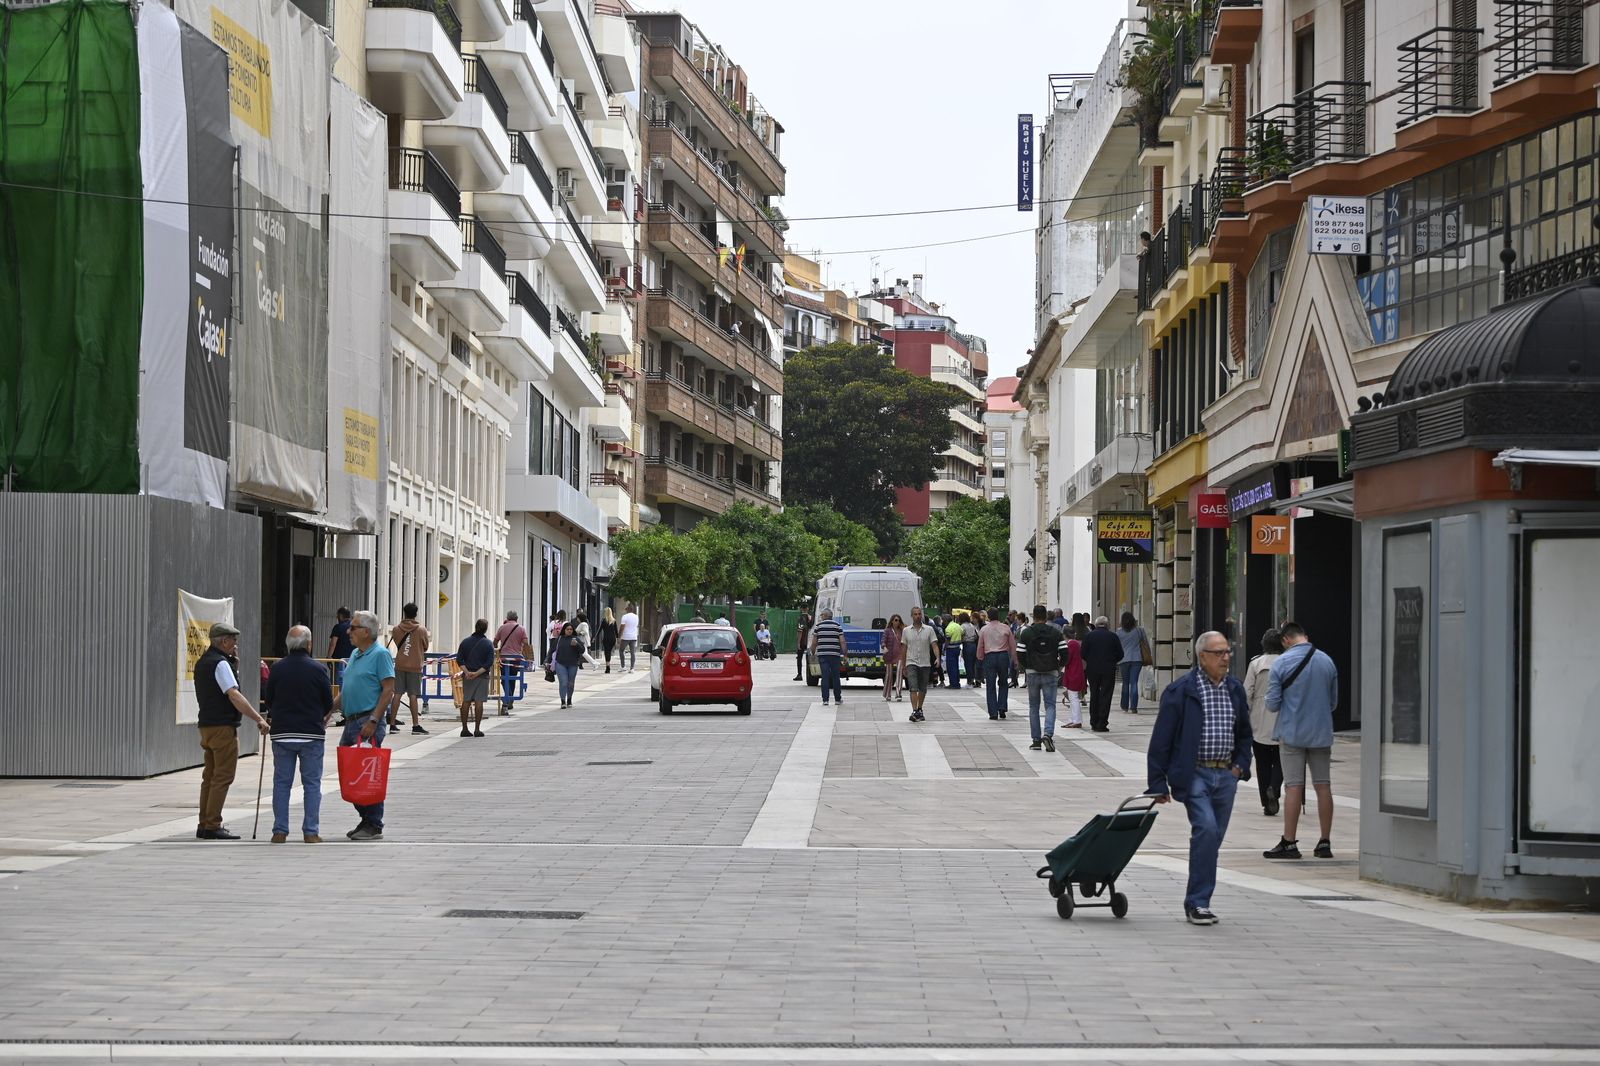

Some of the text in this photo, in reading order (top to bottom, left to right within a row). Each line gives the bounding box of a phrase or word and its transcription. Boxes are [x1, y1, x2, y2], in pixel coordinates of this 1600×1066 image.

[1022, 124, 1030, 155] Radio
[1022, 160, 1030, 200] HUELVA
[1335, 203, 1365, 215] ikesa
[198, 236, 229, 278] Fundación
[199, 305, 226, 363] Cajasol
[1200, 504, 1228, 514] GAES
[1099, 530, 1151, 538] PLUS ULTRA
[848, 579, 910, 590] URGENCIAS
